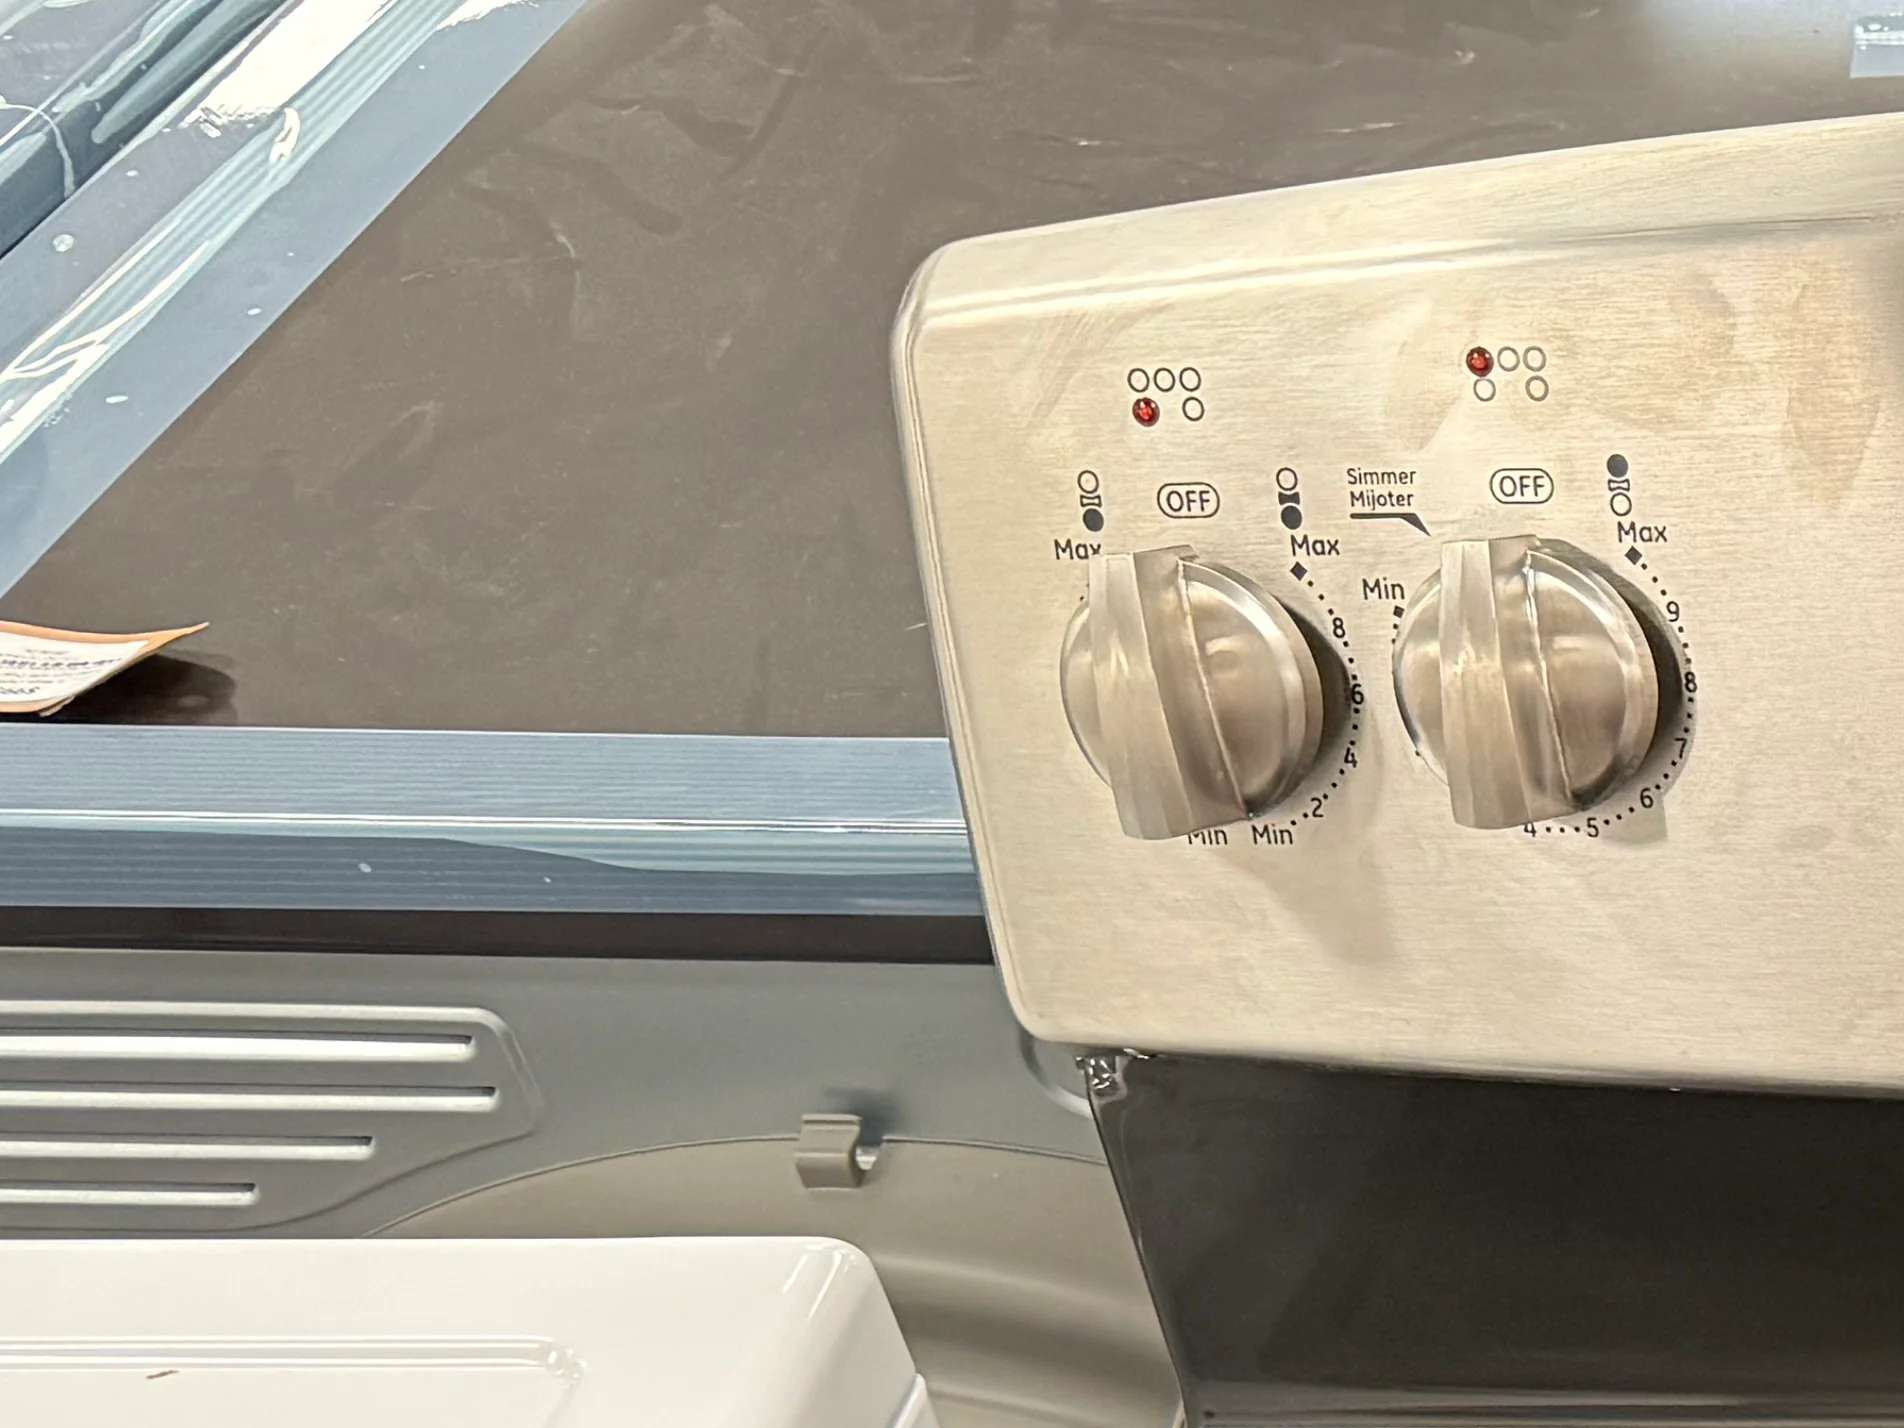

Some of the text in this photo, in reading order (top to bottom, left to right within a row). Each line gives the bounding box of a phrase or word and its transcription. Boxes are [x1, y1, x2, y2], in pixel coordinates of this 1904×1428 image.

[1346, 467, 1417, 486] Simmer
[1498, 475, 1545, 498] OFF
[1165, 489, 1211, 513] OFF
[1349, 489, 1414, 511] Mijoter
[1617, 520, 1668, 544] Max
[1054, 540, 1101, 559] Max
[1290, 534, 1341, 557] Max
[1361, 578, 1405, 601] Min
[1665, 600, 1680, 623] 9
[1332, 616, 1346, 639] 8
[1684, 671, 1698, 693] 8
[1343, 746, 1358, 768] 4
[1310, 796, 1324, 818] 2
[1639, 787, 1654, 809] 6
[1252, 823, 1292, 846] Min
[1586, 816, 1600, 838] 5
